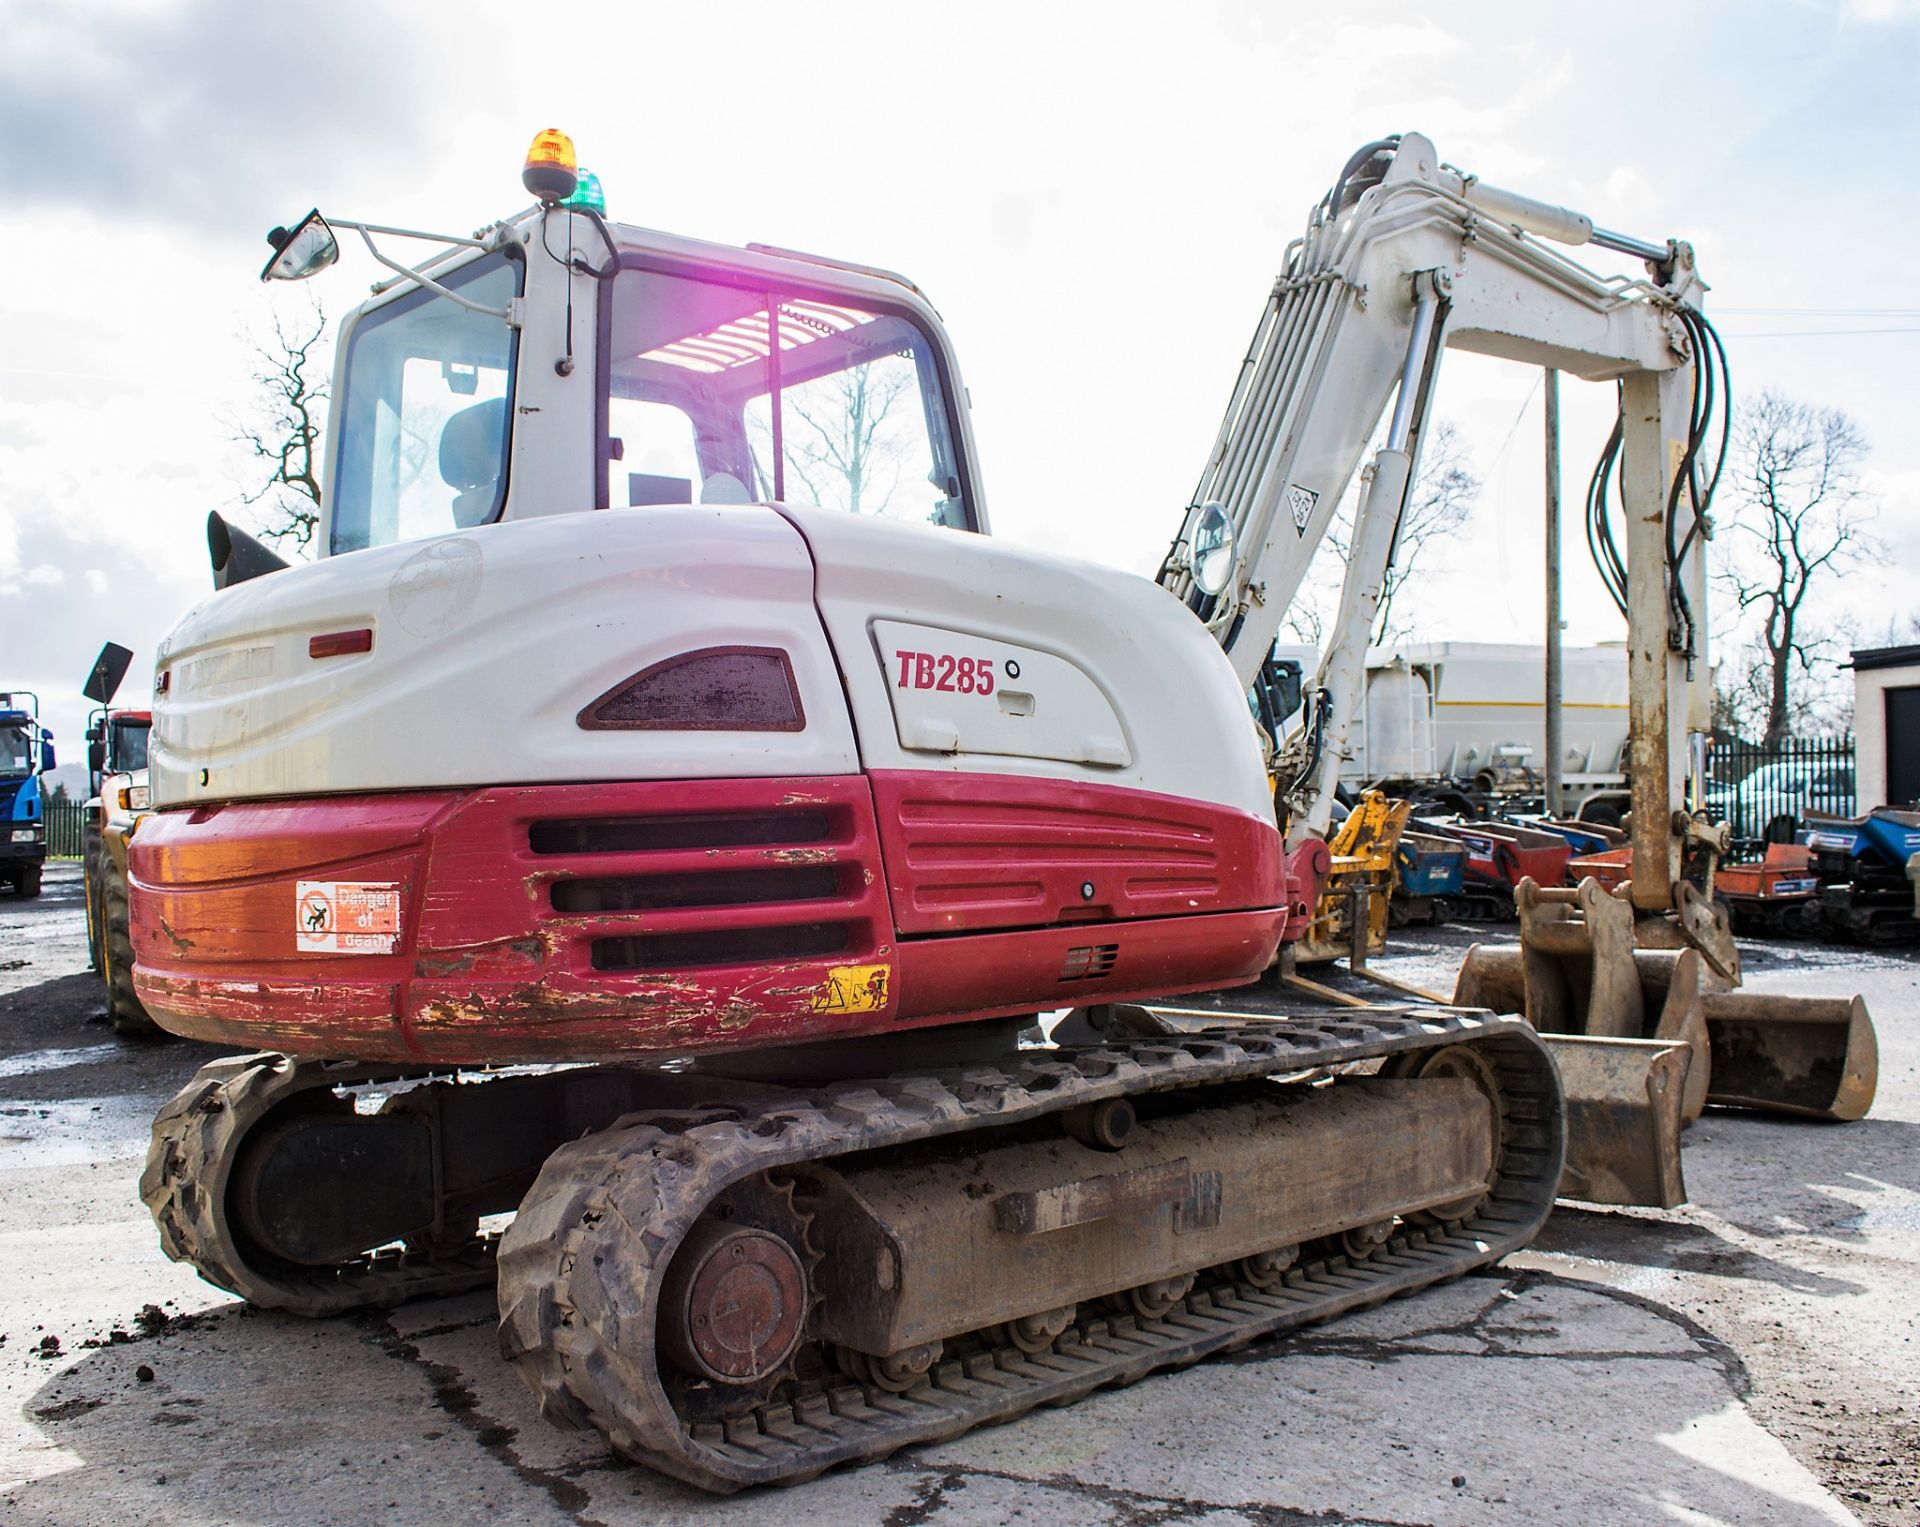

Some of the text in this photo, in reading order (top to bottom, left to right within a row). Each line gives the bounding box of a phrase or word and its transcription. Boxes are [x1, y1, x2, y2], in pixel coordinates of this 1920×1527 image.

[896, 650, 994, 696] TB285
[339, 888, 393, 908] Danger
[357, 911, 373, 928] of
